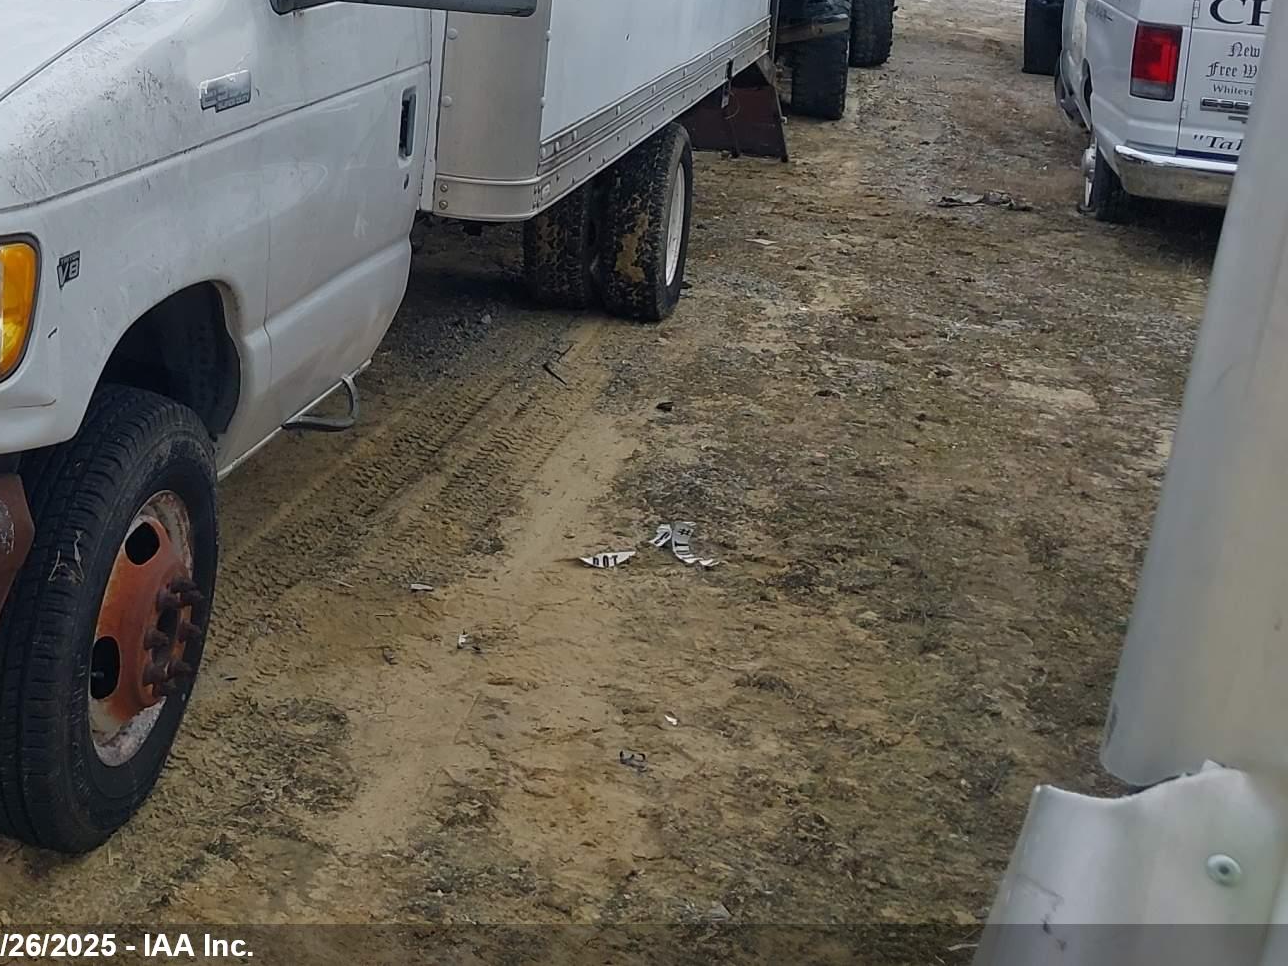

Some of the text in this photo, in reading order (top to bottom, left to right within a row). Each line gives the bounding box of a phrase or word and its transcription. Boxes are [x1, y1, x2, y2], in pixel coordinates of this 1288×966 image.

[1228, 42, 1261, 58] New
[1205, 61, 1238, 78] Free
[57, 259, 79, 288] V8
